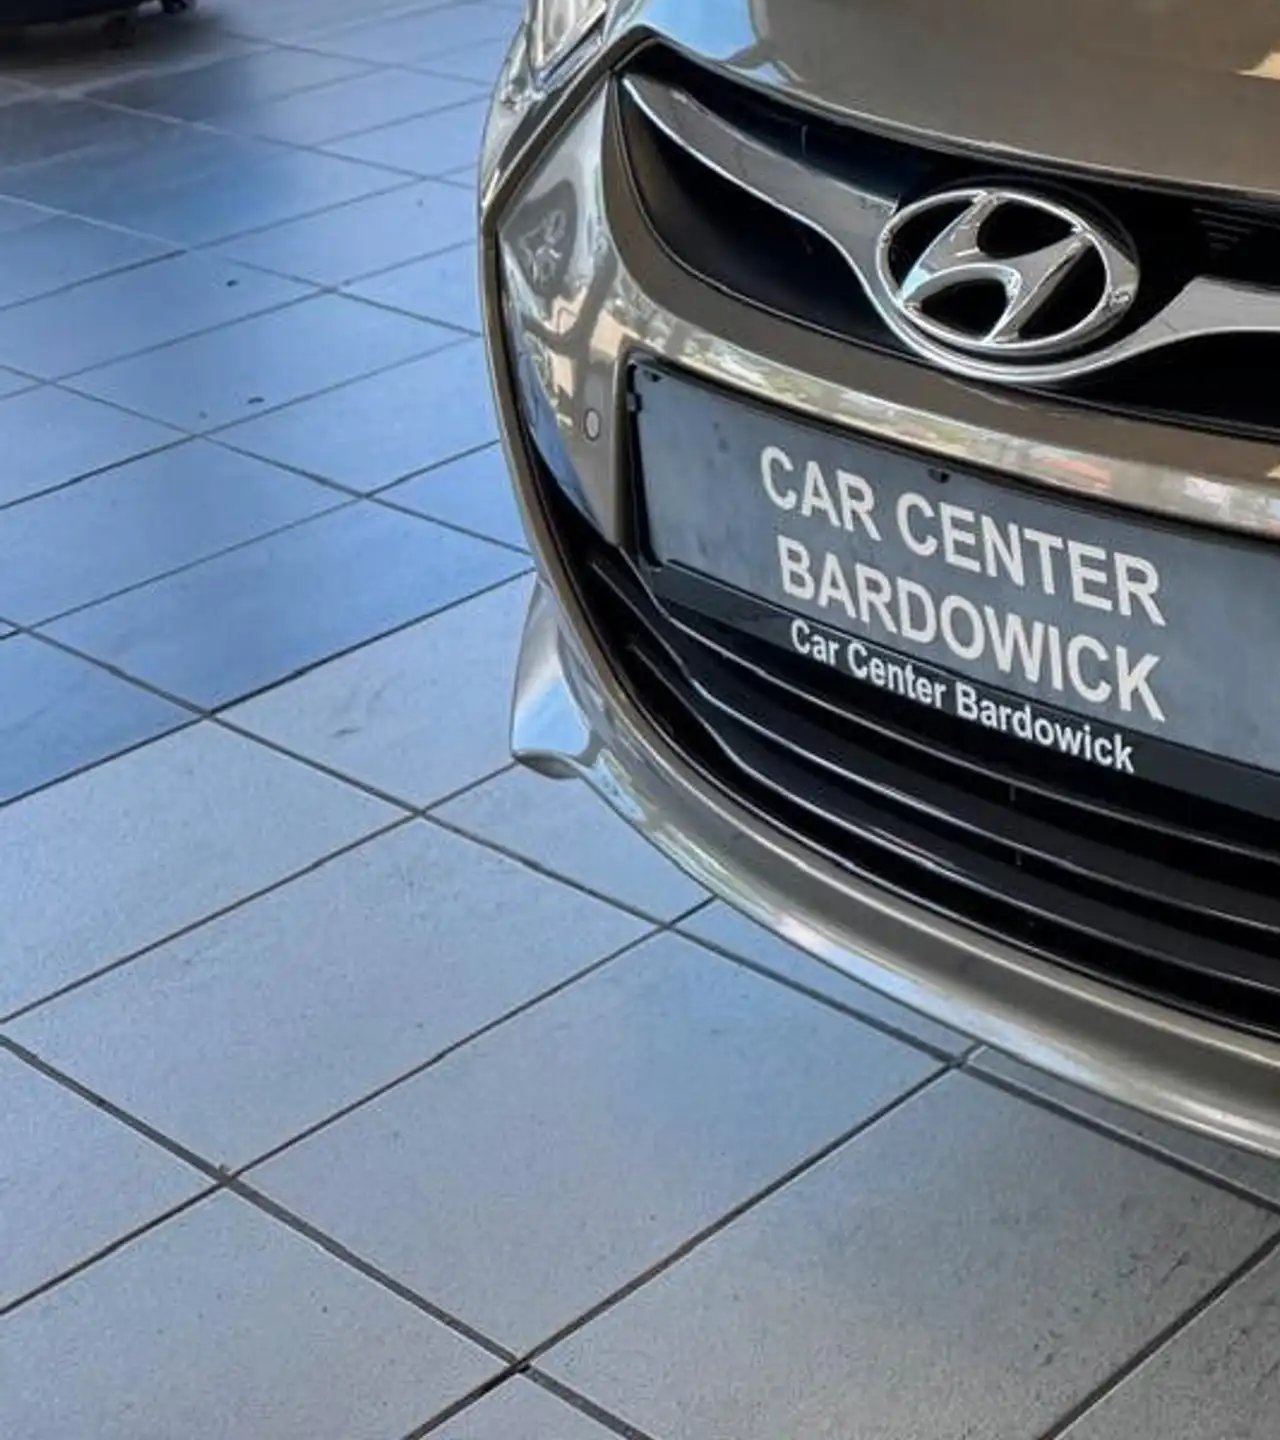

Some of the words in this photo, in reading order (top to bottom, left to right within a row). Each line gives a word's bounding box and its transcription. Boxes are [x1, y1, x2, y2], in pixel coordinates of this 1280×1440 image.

[760, 445, 882, 542] CAR
[896, 491, 1166, 627] CENTER
[776, 534, 1166, 723] BARDOWICK
[789, 617, 840, 667] Car
[845, 641, 948, 710] Center
[955, 680, 1136, 774] Bardowick
